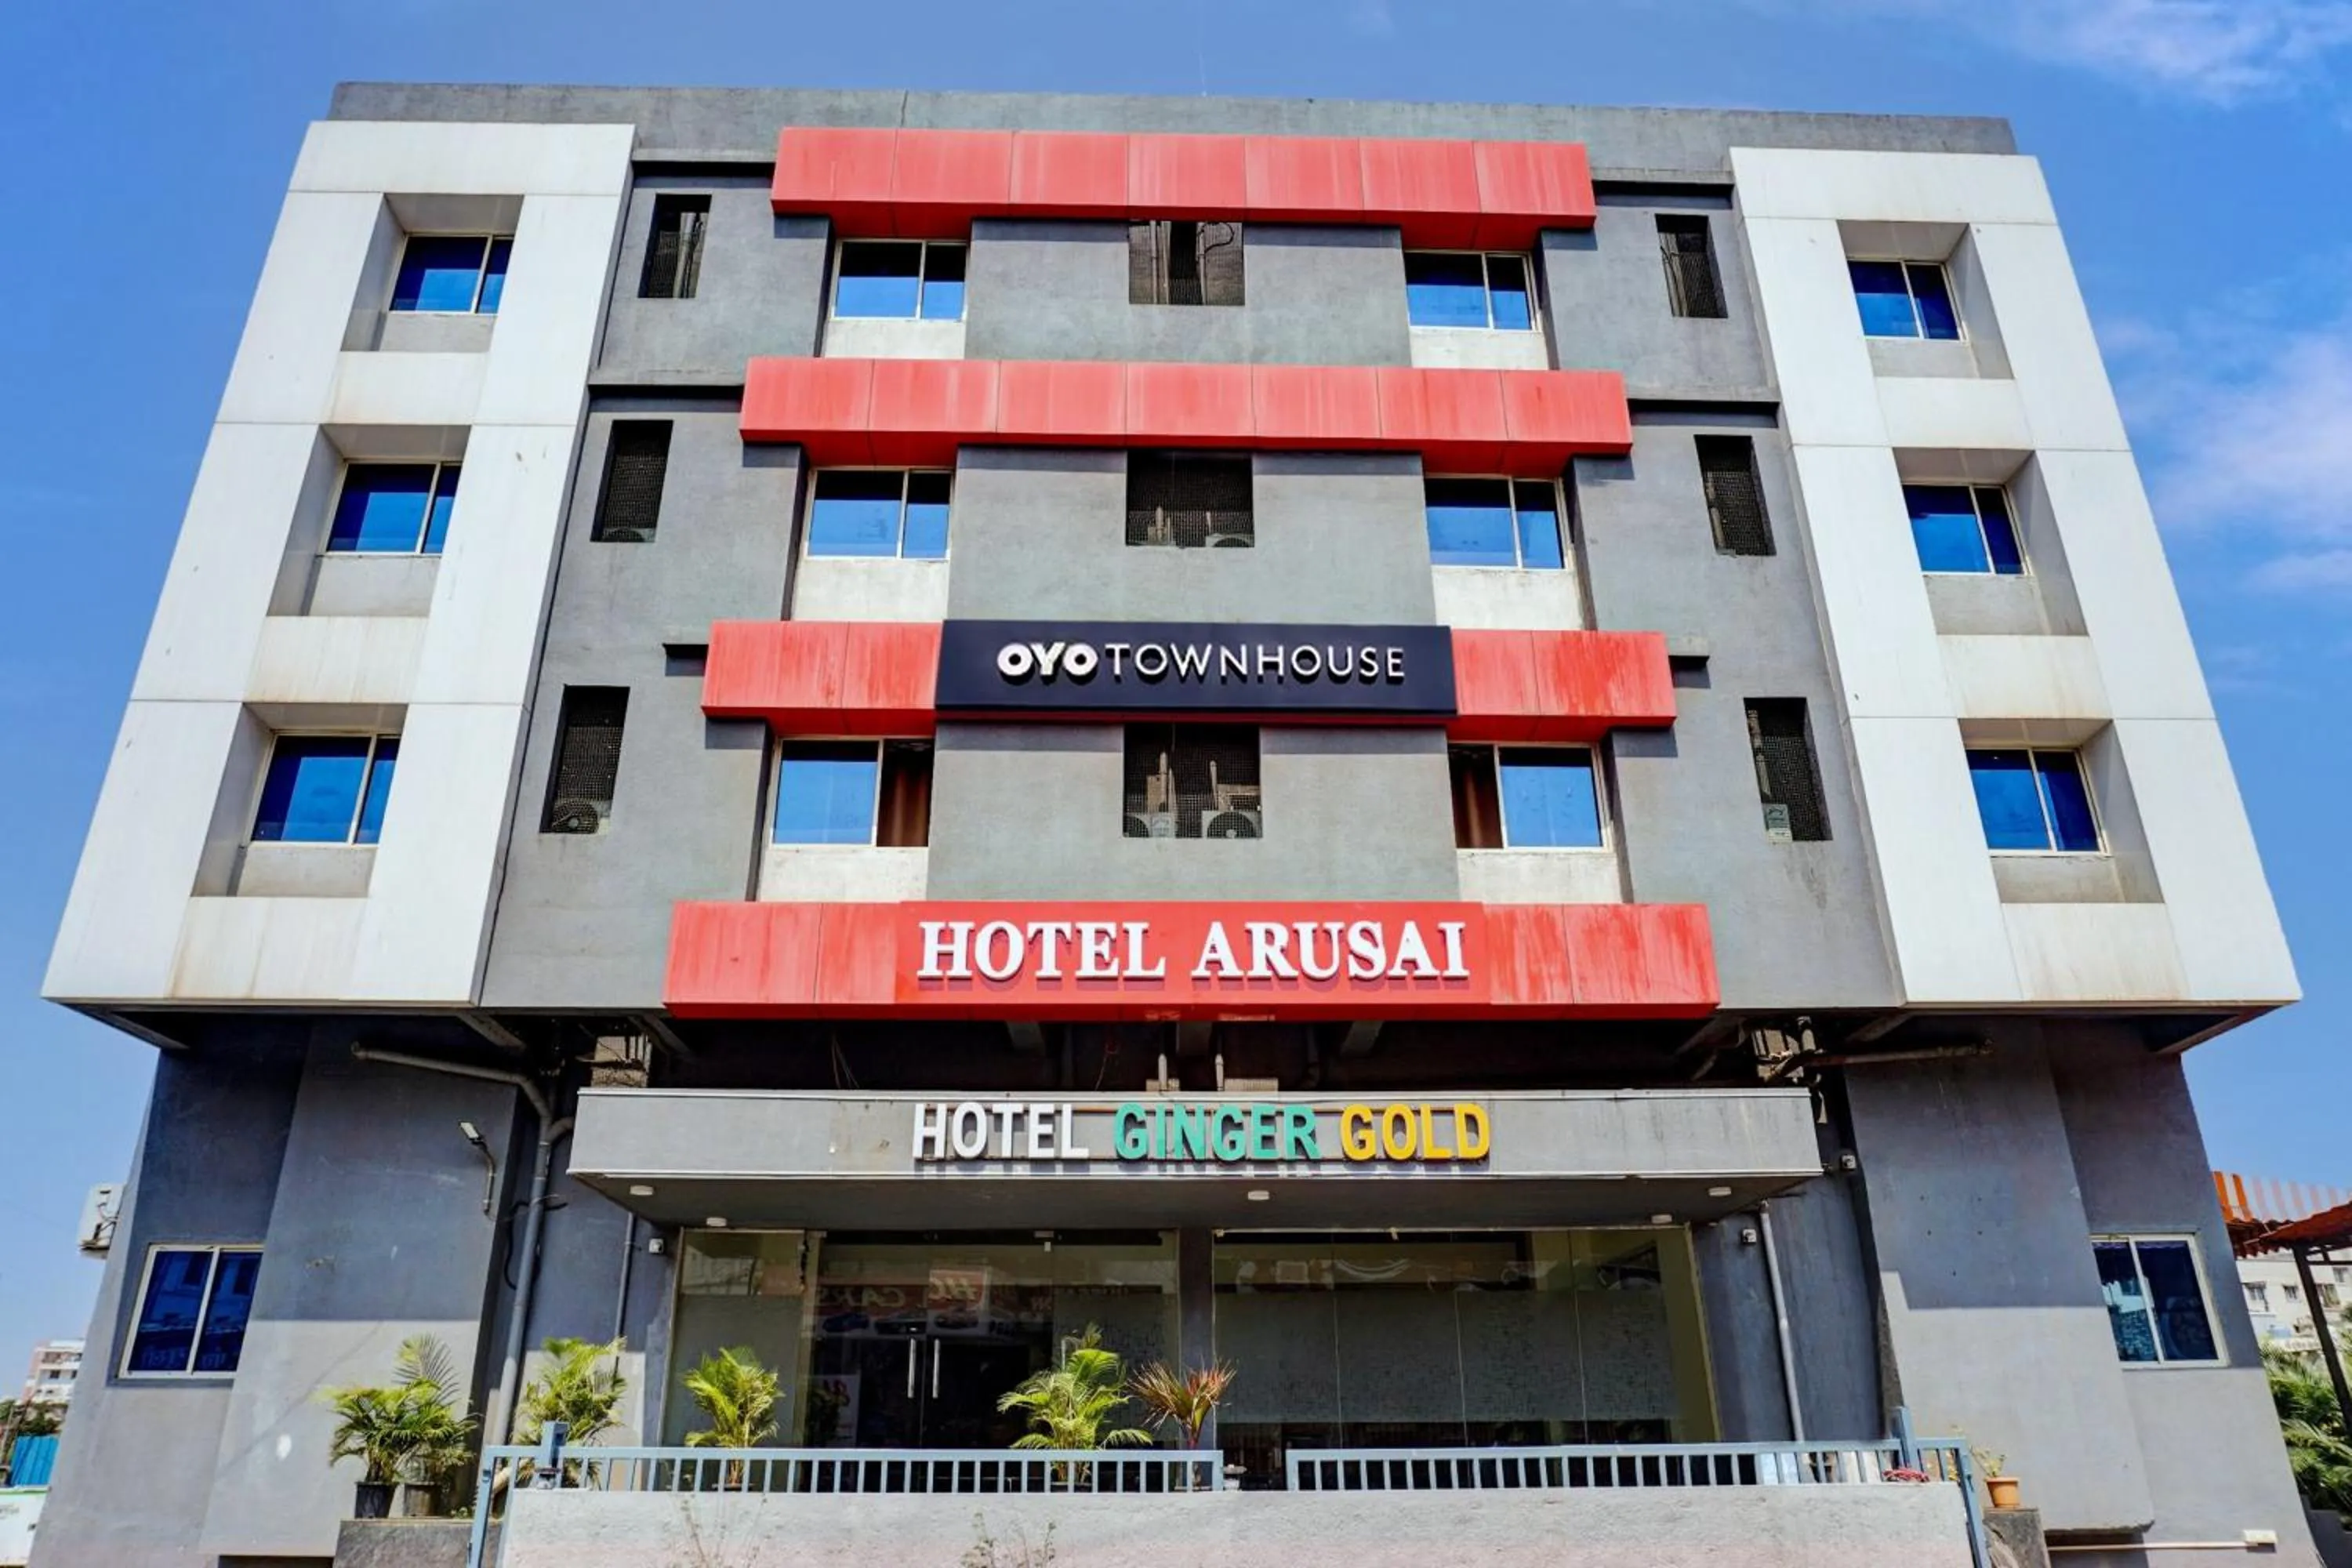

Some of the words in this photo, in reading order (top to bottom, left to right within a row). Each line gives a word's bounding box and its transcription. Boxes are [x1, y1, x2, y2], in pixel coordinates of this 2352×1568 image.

[996, 641, 1098, 677] OYO
[1105, 642, 1406, 678] TOWNHOUSE
[916, 920, 1167, 981] HOTEL
[1190, 920, 1470, 981] ARUSAI
[912, 1102, 1090, 1160] HOTEL
[1113, 1103, 1322, 1161] GINGER
[1340, 1103, 1491, 1161] GOLD
